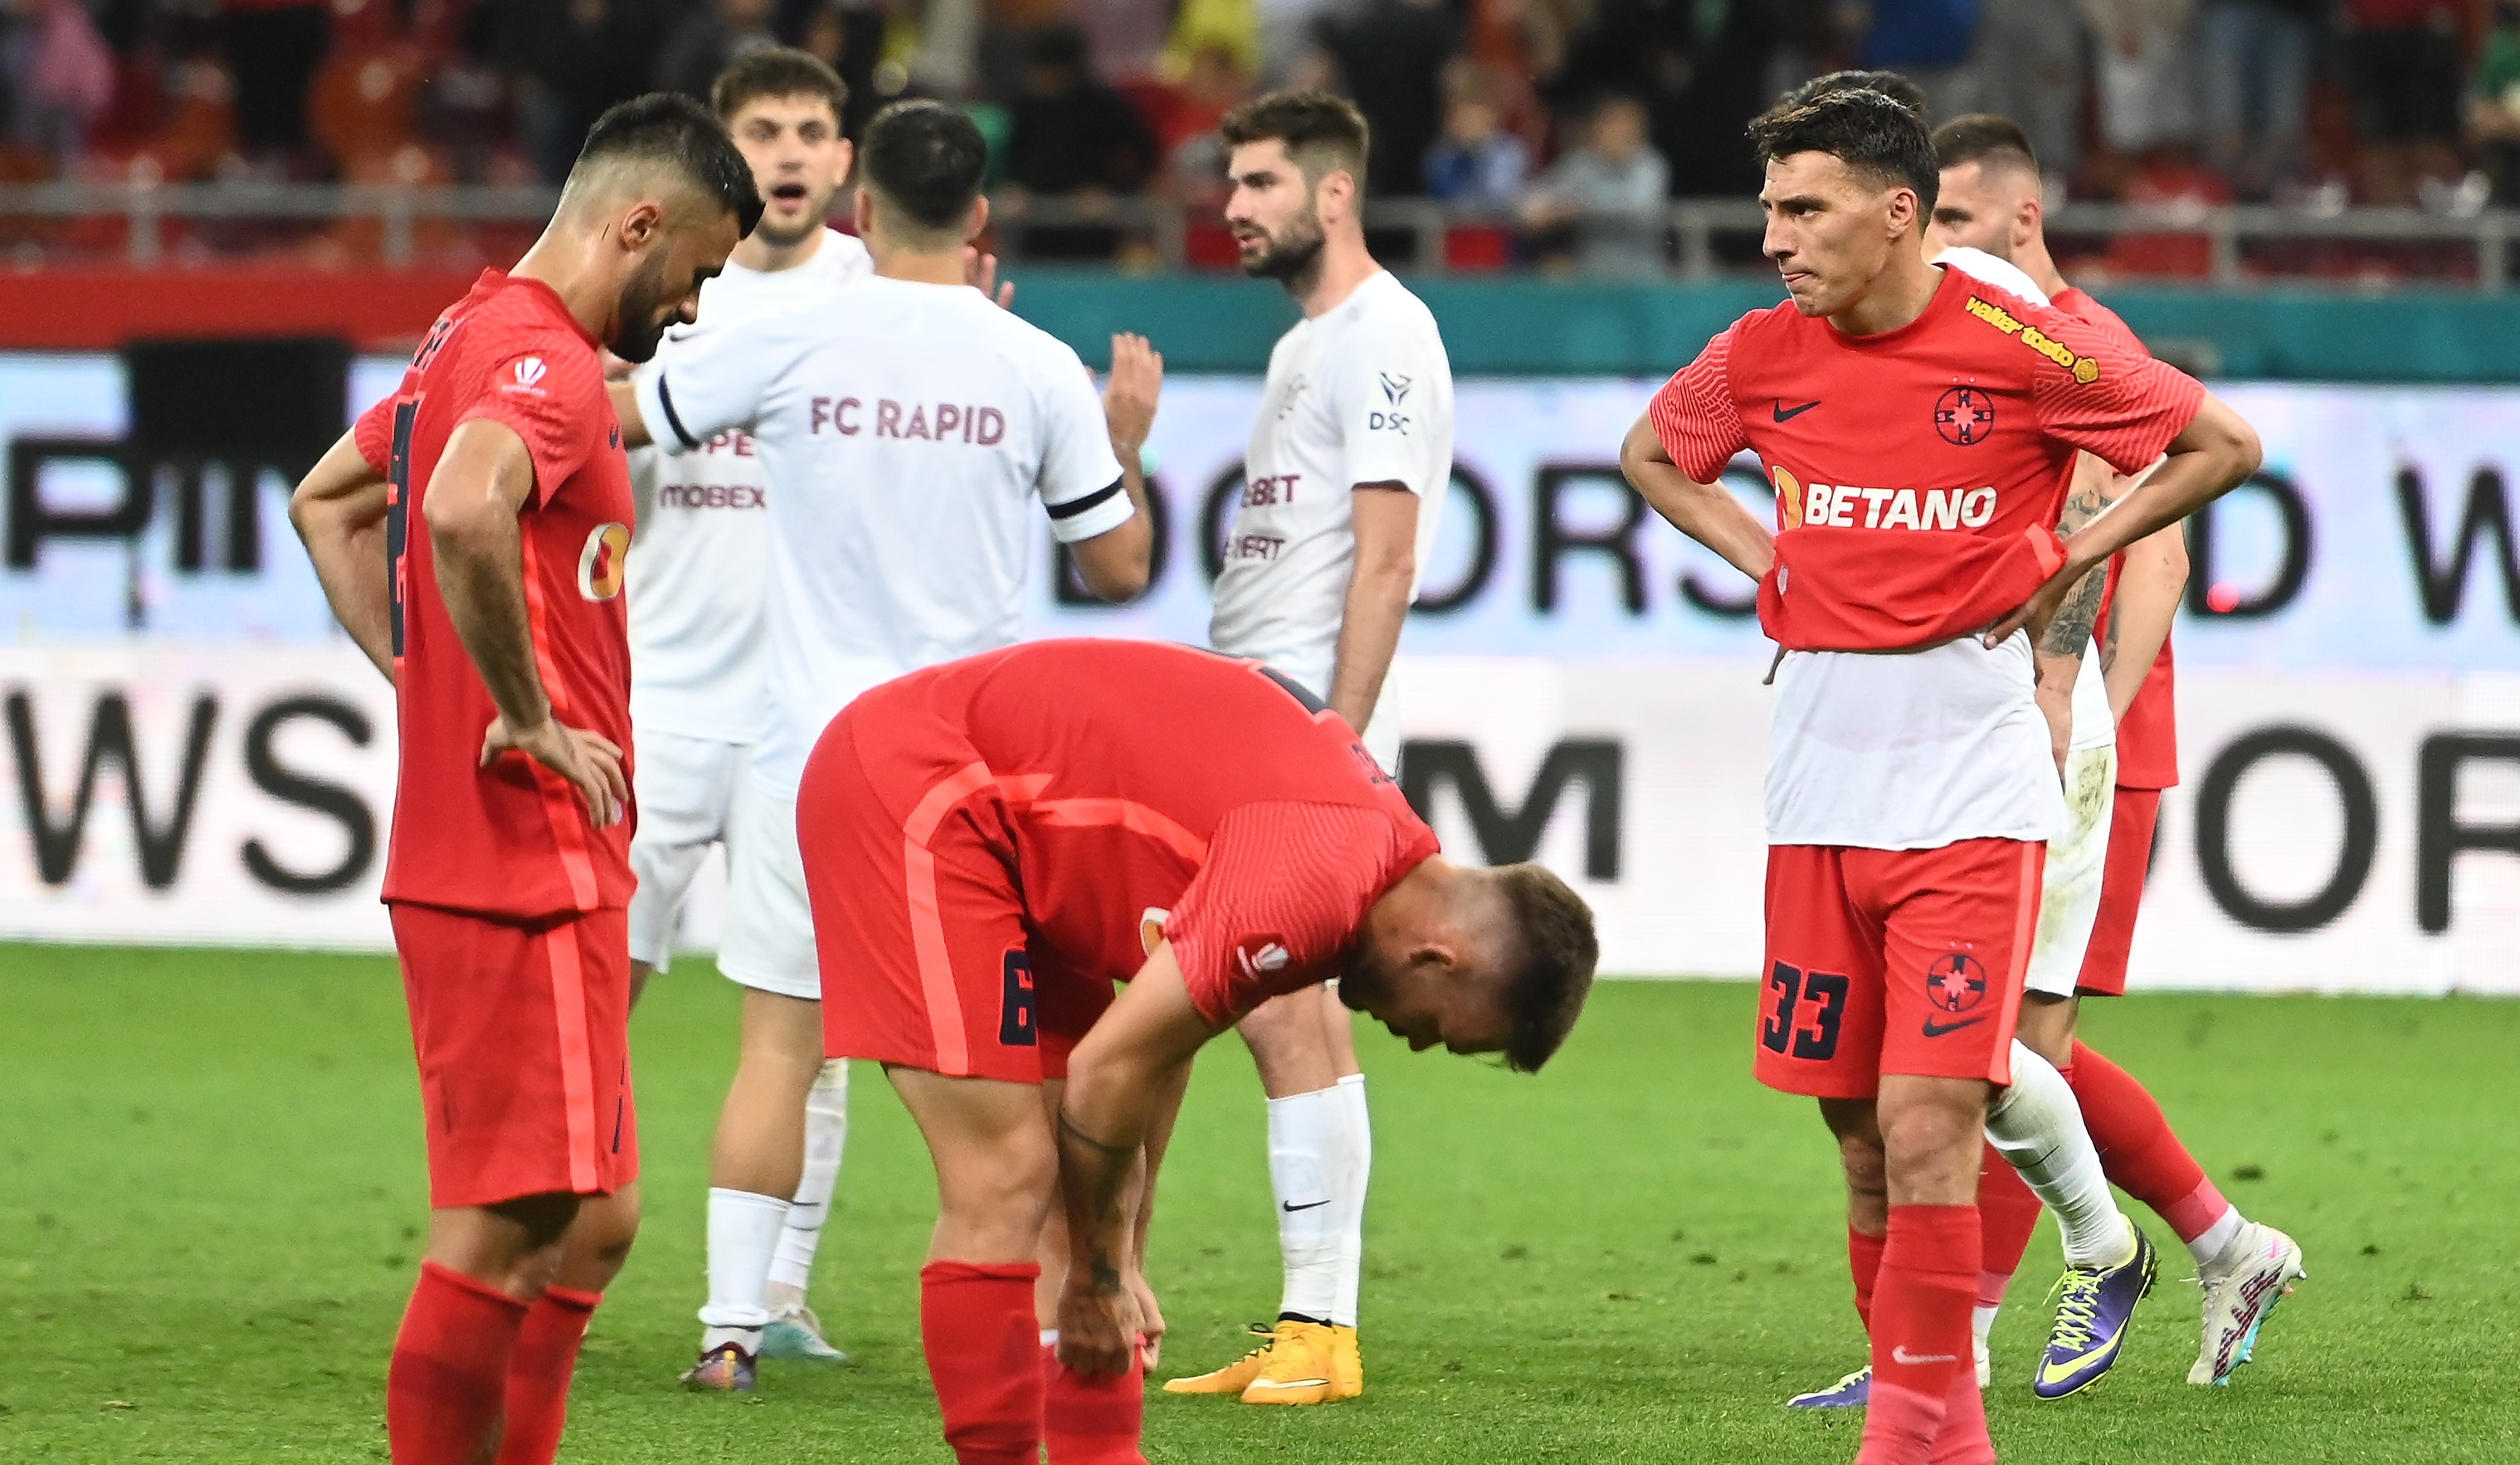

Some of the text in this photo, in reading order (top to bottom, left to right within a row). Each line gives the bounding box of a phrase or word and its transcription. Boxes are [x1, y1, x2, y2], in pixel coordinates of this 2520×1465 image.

[2020, 326, 2074, 367] tosto
[810, 397, 1006, 447] FC RAPID
[1369, 412, 1410, 436] DSC
[1805, 482, 1998, 531] BETANO
[2, 682, 376, 896] WS
[1762, 960, 1850, 1061] 33
